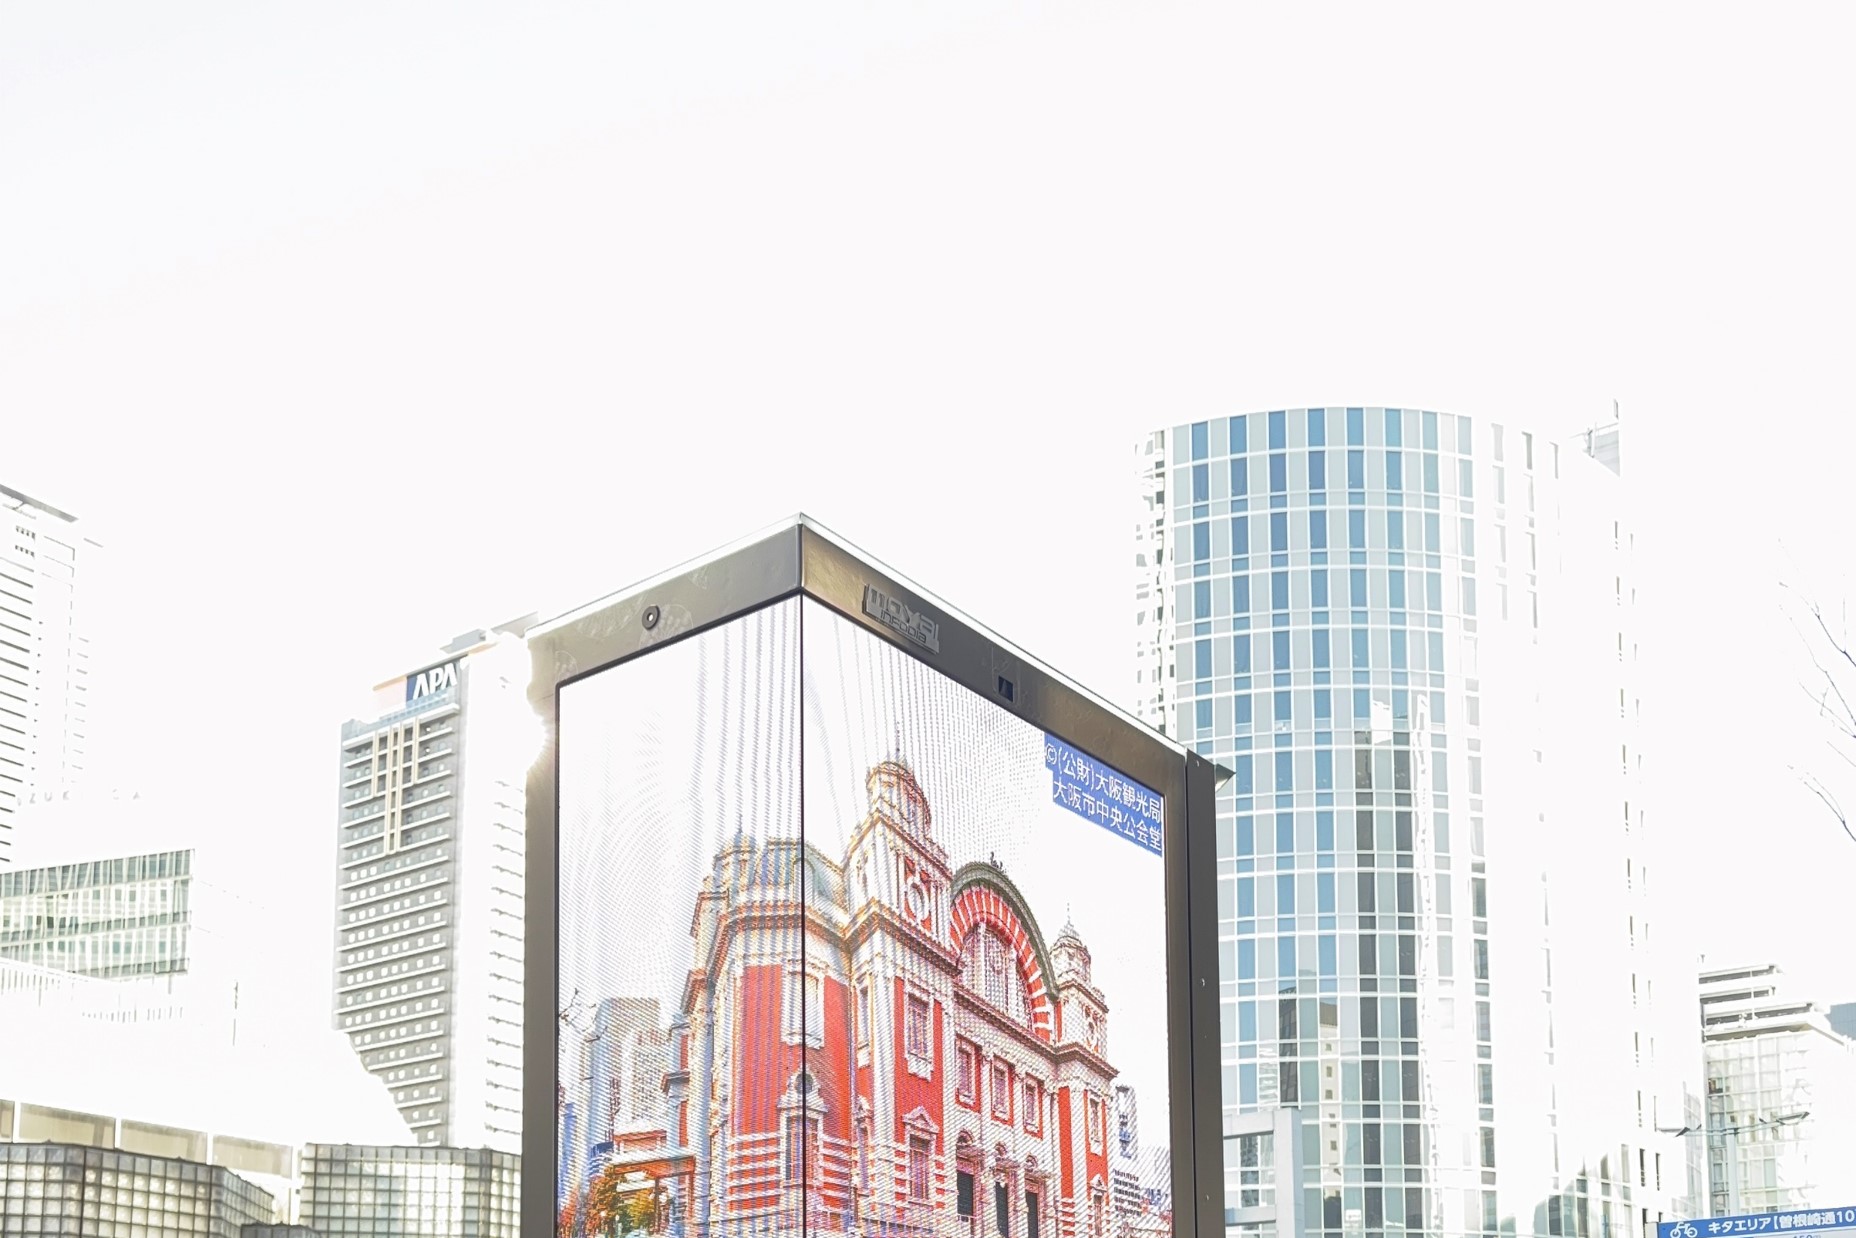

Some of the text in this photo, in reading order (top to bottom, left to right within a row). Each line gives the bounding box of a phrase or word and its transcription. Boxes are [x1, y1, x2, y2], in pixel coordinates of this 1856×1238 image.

[413, 662, 458, 700] APA
[1053, 776, 1162, 851] 大阪市中央公会堂
